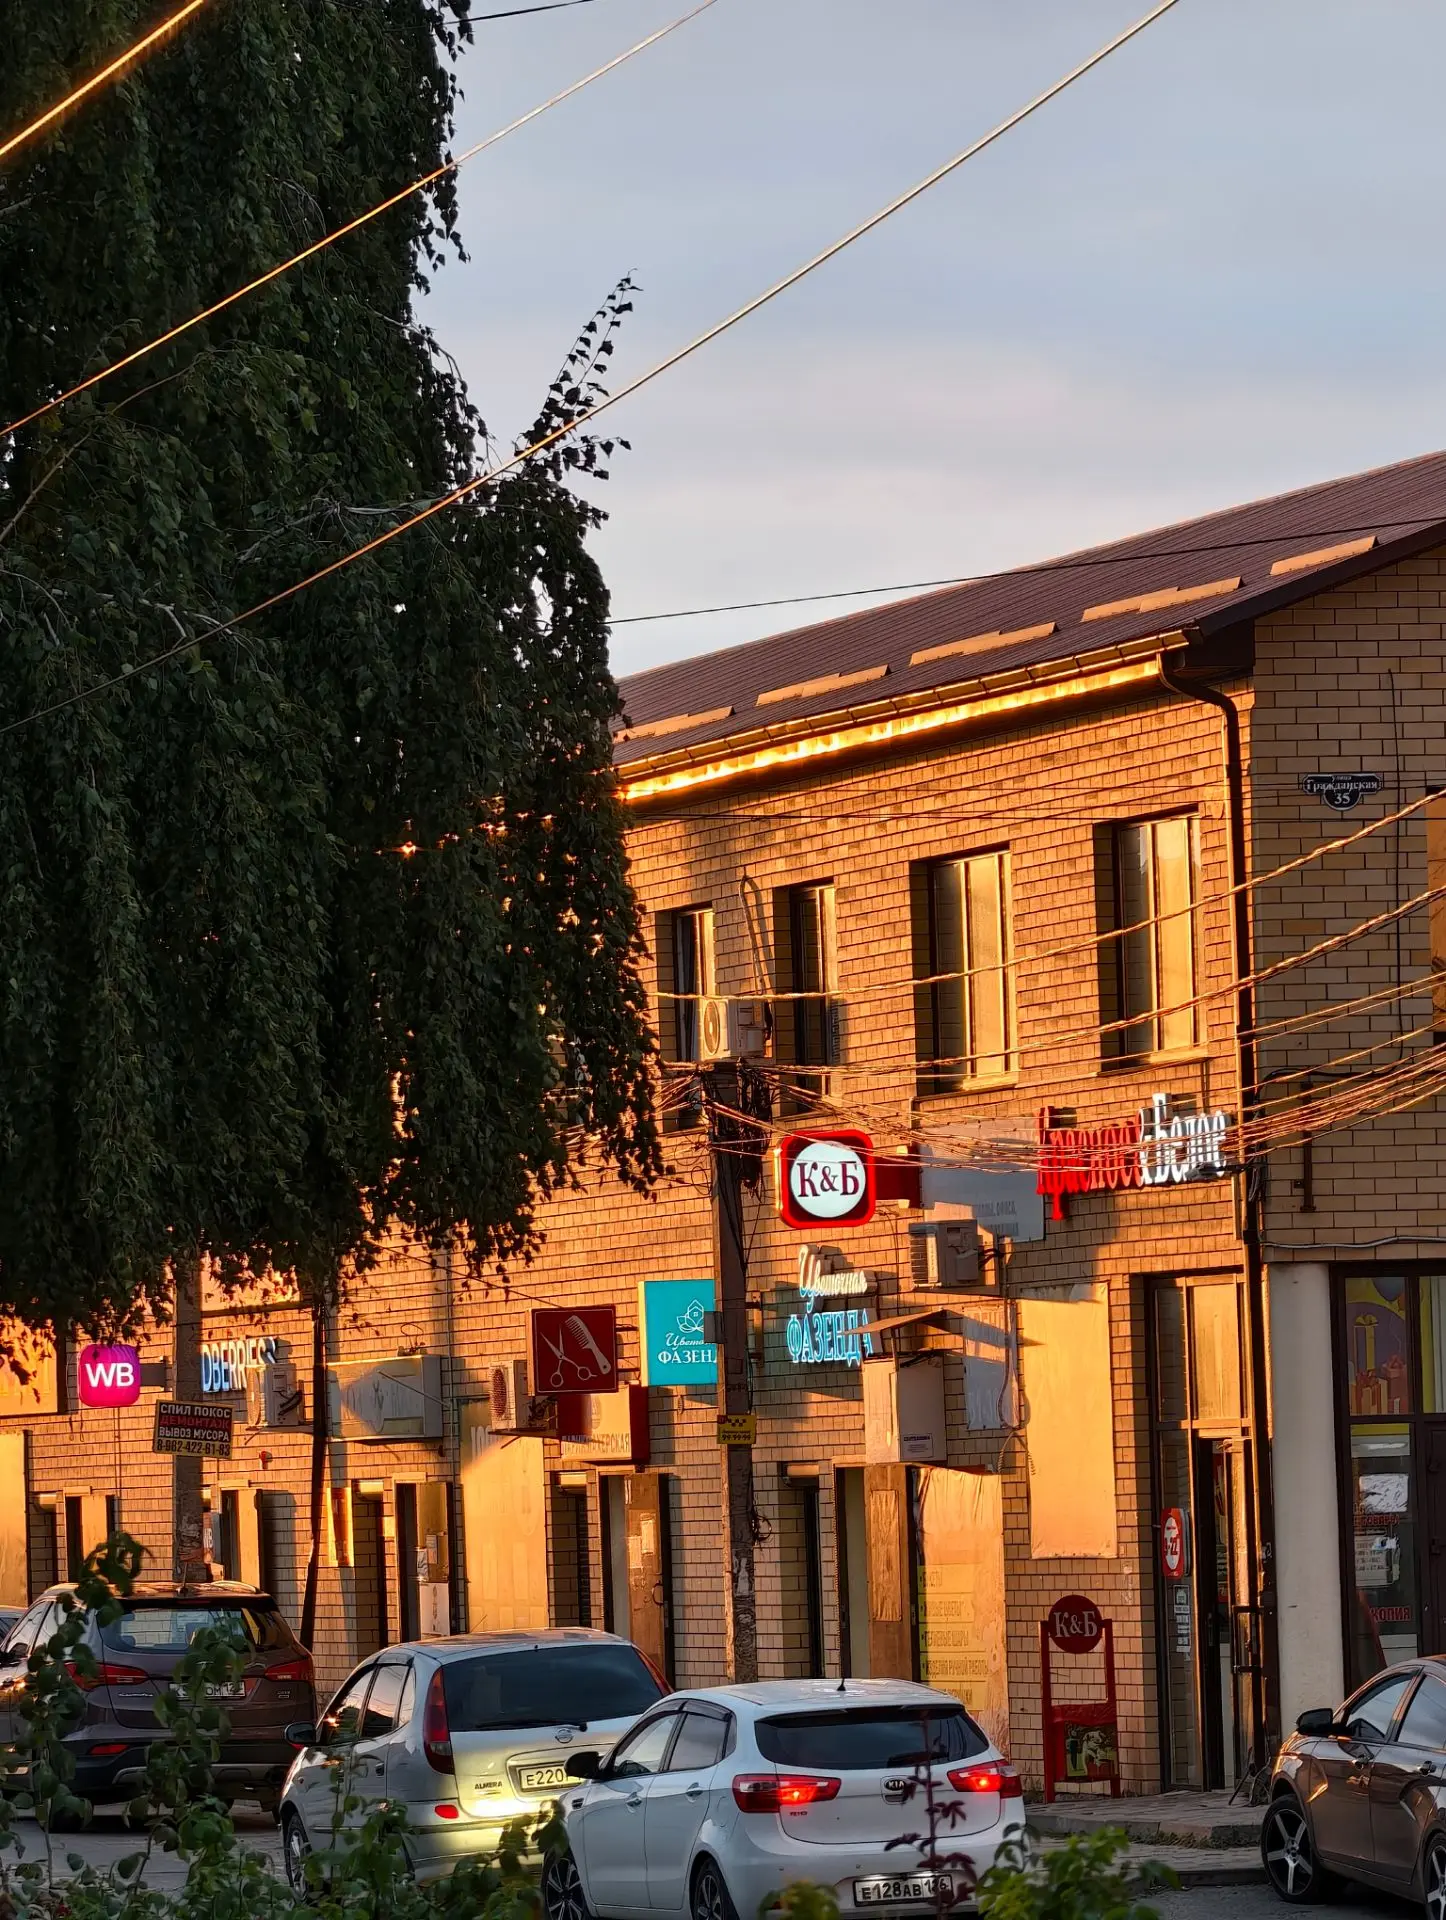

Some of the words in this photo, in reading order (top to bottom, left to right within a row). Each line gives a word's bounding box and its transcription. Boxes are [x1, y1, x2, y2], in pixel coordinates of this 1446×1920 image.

[1306, 779, 1378, 793] Гражданская
[1334, 792, 1350, 804] 35
[796, 1160, 860, 1198] К&Б
[786, 1308, 874, 1367] ФАЗЕНДА
[657, 1349, 718, 1364] ФАЗЕН
[85, 1362, 135, 1388] WB
[160, 1404, 191, 1416] СПИЛ
[194, 1406, 232, 1418] ПОКОС
[160, 1415, 229, 1429] ДЕМОНТАЖ
[159, 1426, 191, 1438] ВЫВОЗ
[193, 1428, 230, 1441] МУСОРА
[1053, 1610, 1098, 1638] К&Б
[474, 1781, 503, 1790] ALMERA
[888, 1780, 905, 1790] KIA
[861, 1881, 922, 1901] Е128АВ
